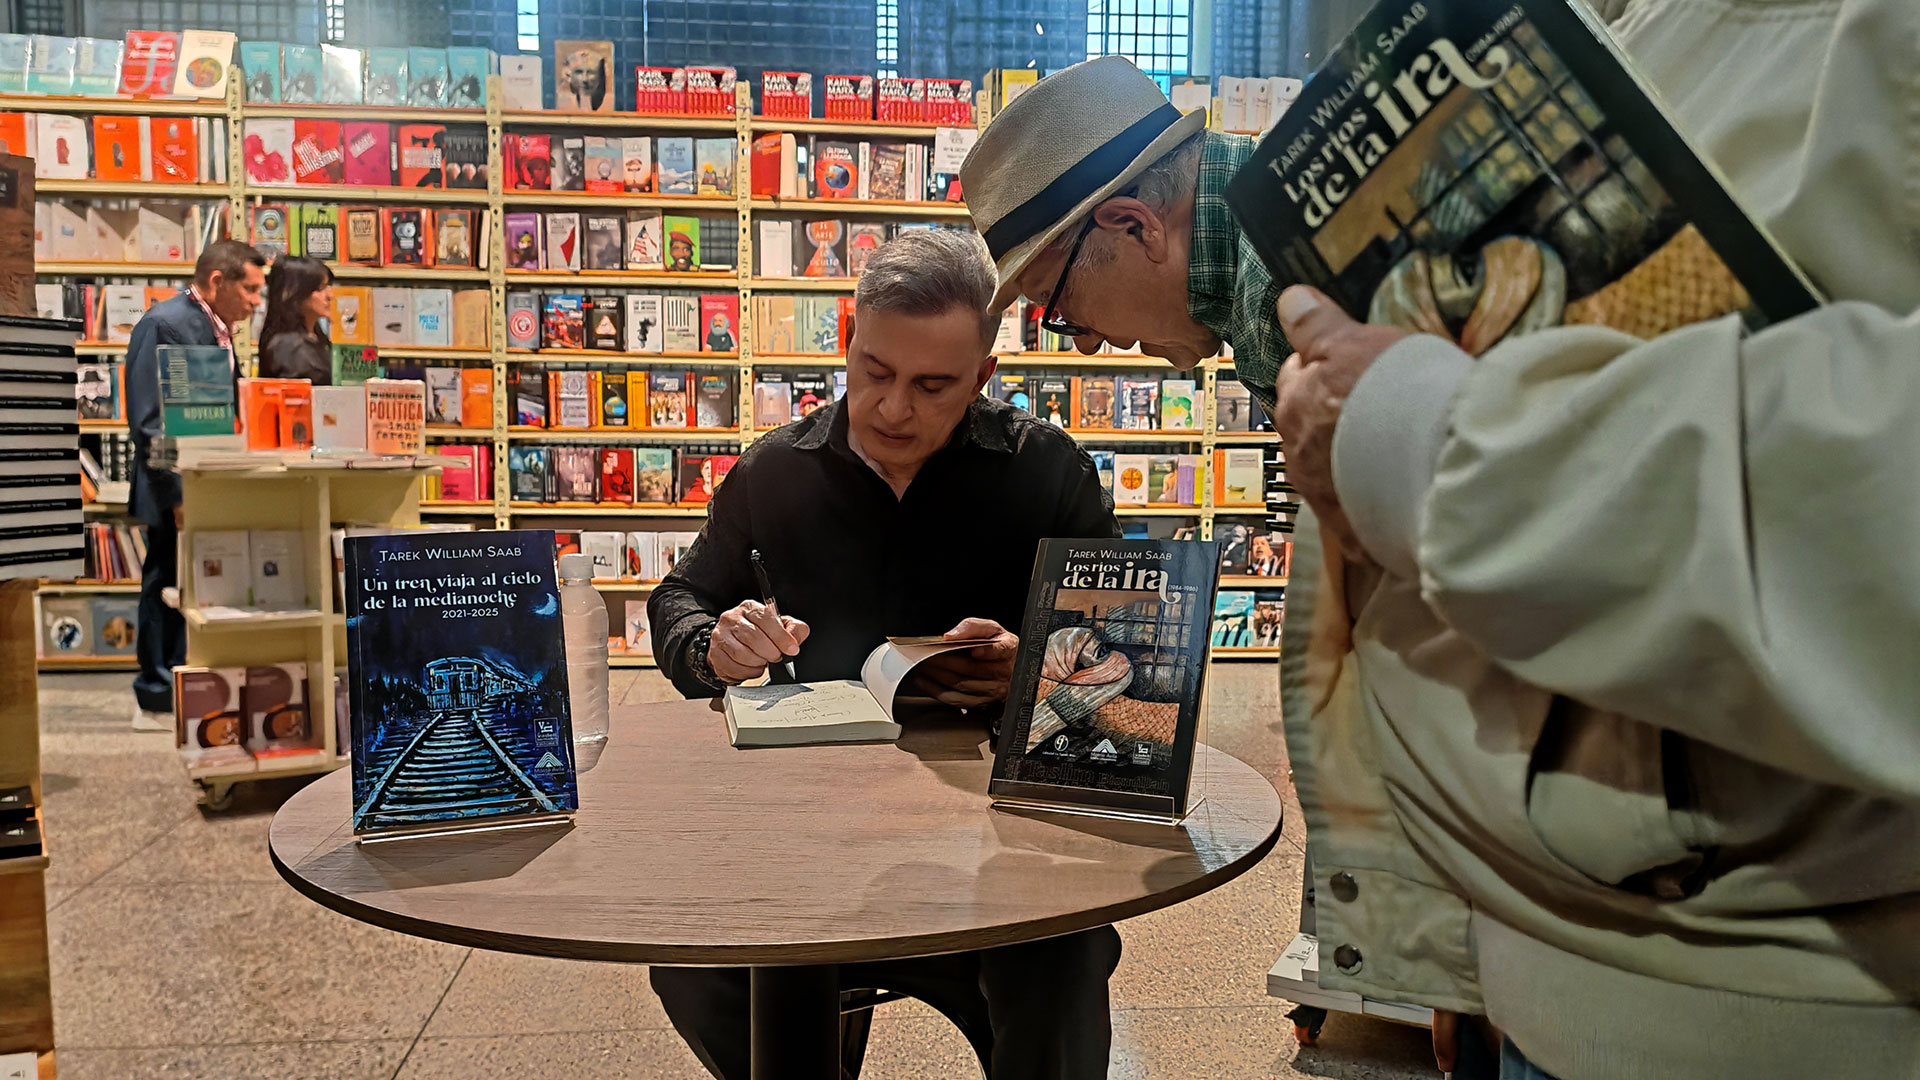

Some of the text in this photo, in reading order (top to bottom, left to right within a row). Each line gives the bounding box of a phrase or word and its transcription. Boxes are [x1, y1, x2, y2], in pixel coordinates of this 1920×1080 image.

[1268, 1, 1428, 178] TAREK WILLIAM SAAB
[1303, 38, 1510, 228] de la ira
[1283, 156, 1326, 204] Los
[379, 545, 522, 562] TAREK WILLIAM SAAB
[1068, 549, 1173, 561] TAREK WILLIAM SAAB
[1065, 561, 1090, 572] Los
[363, 571, 542, 593] Un tren viaja al cielo
[1062, 561, 1182, 604] de la ira
[363, 589, 518, 610] de la medianoche
[442, 607, 499, 619] 2021-2025
